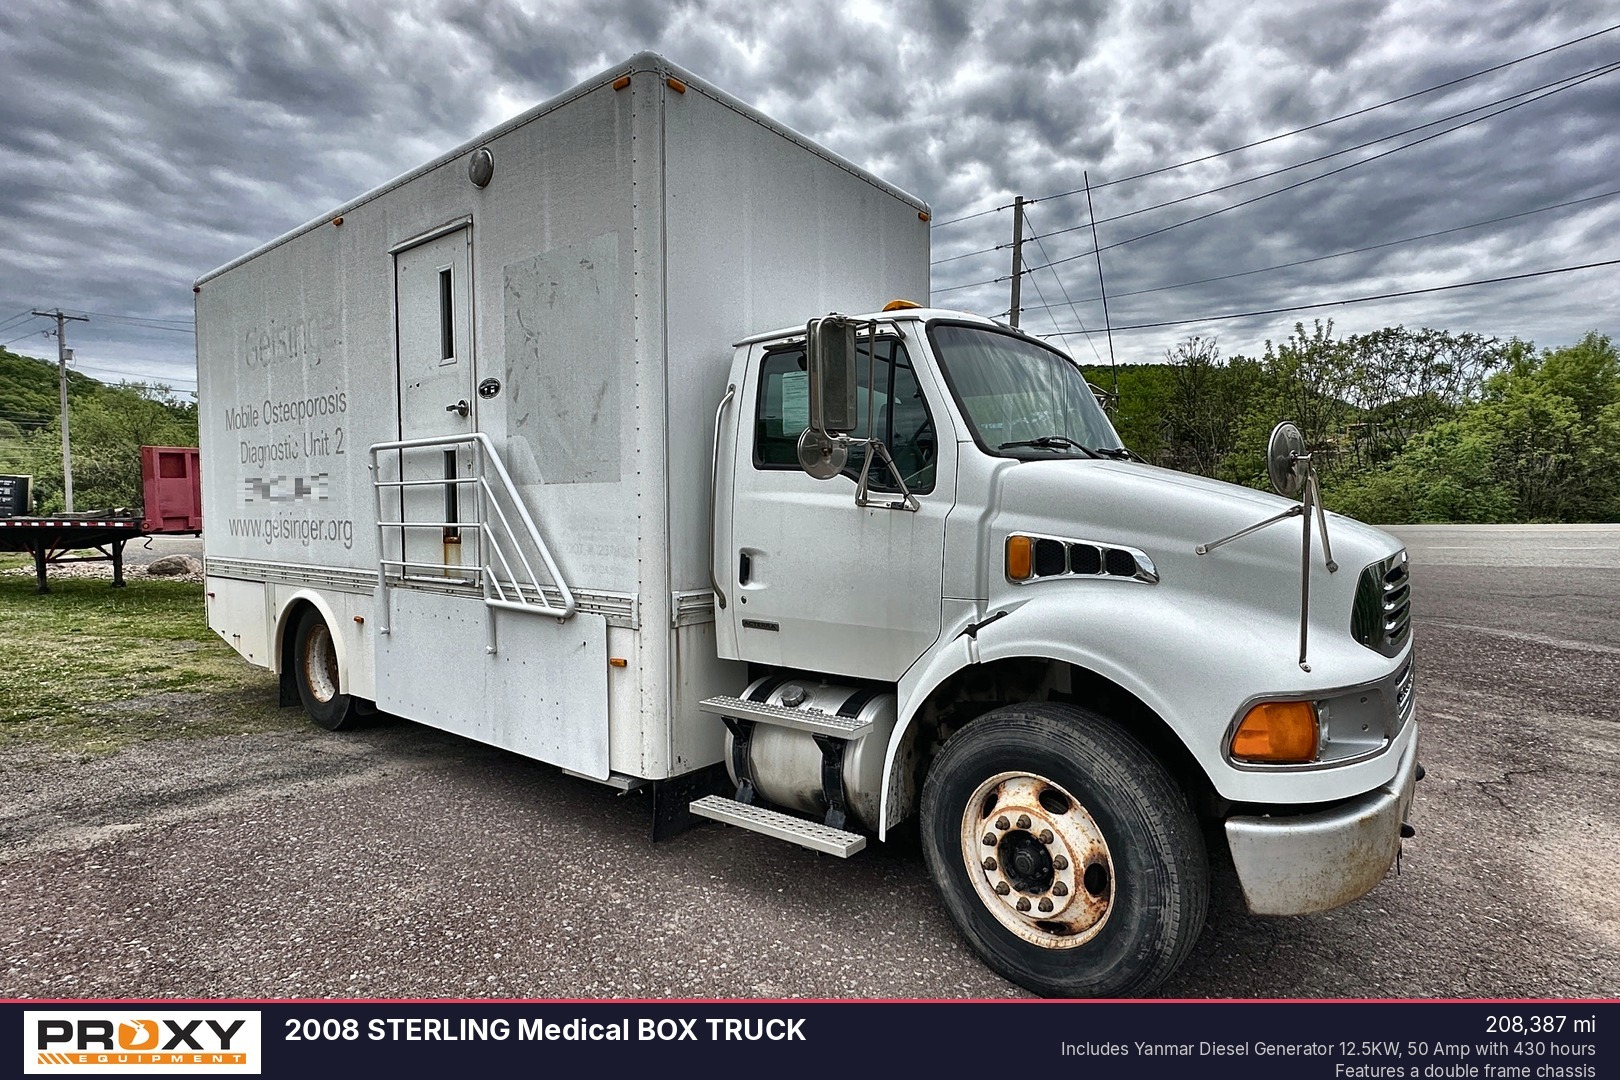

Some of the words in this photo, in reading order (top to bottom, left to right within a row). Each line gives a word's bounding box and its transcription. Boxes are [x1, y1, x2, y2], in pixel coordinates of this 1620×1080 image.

[225, 404, 259, 431] Mobile
[263, 386, 347, 425] Osteoporosis
[240, 434, 299, 469] Diagnostic
[303, 429, 330, 458] Unit
[335, 427, 345, 454] 2
[228, 511, 353, 549] www.geisinger.org
